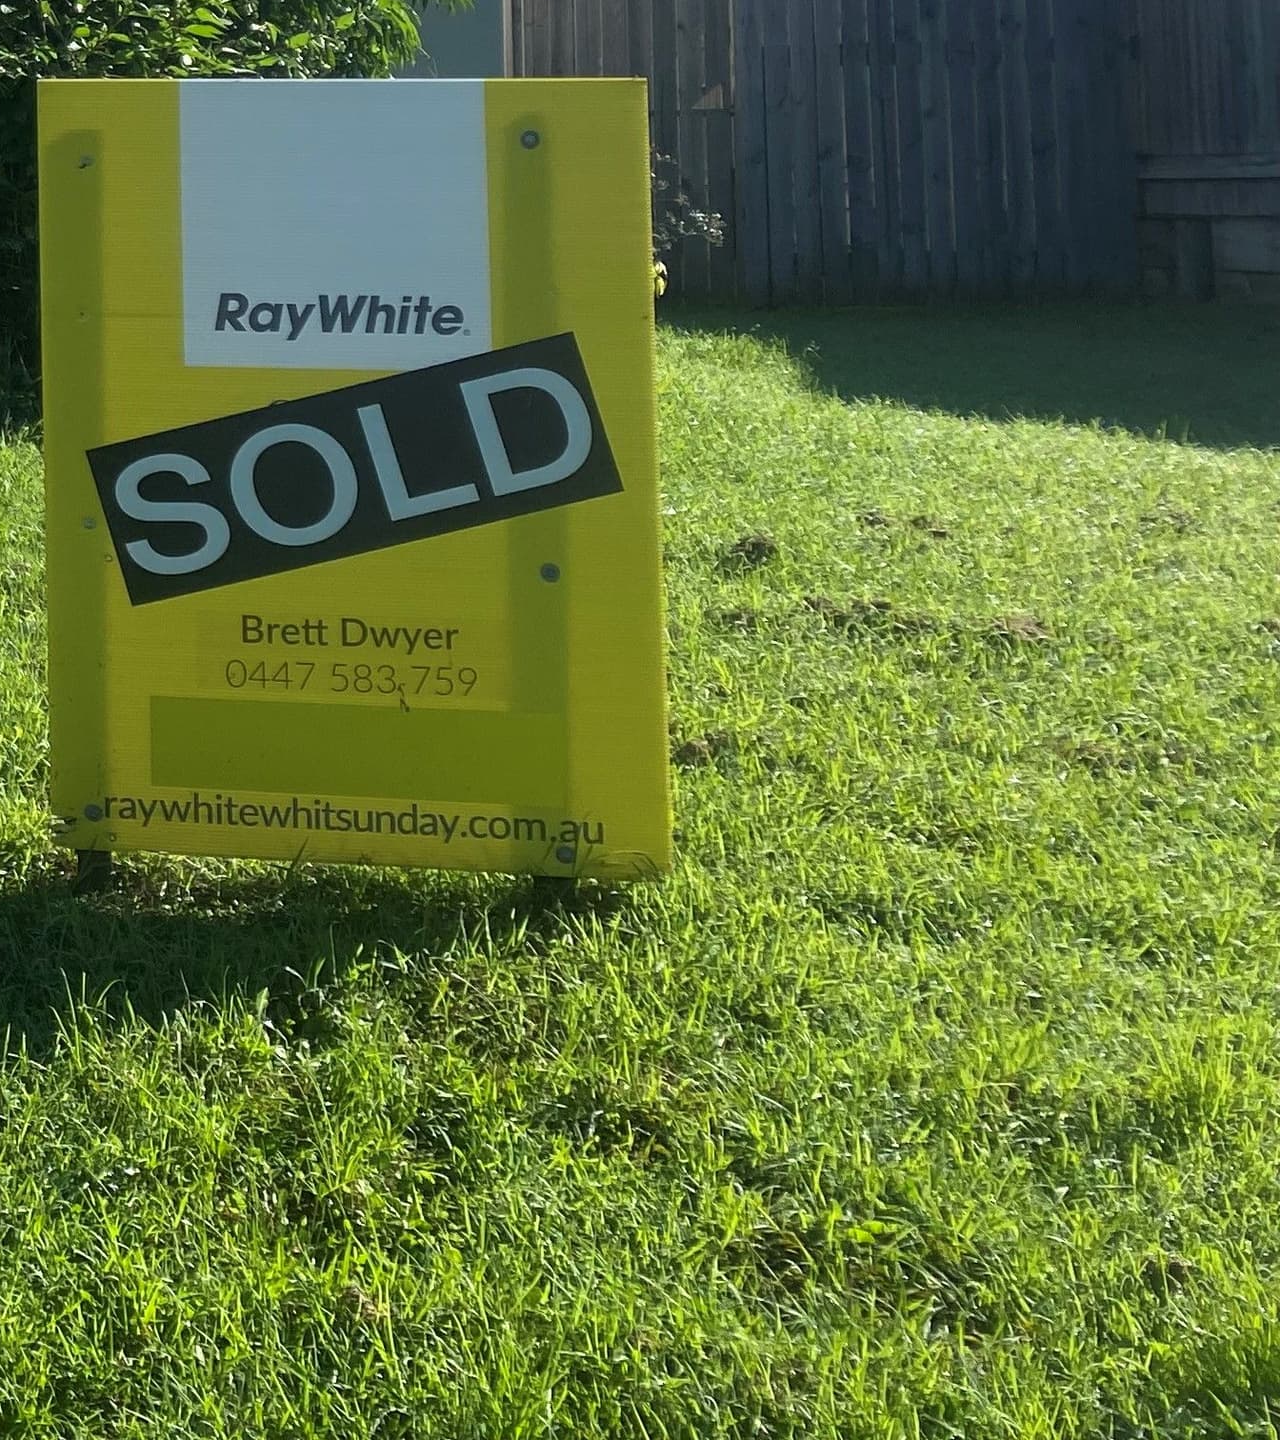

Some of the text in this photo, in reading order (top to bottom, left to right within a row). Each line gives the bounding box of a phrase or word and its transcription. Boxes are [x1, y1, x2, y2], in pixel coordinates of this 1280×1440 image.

[113, 367, 593, 575] SOLD
[241, 614, 459, 655] Brett Dwyer
[225, 659, 478, 697] 0447 583 759
[103, 791, 605, 846] raywhitewhitsunday.com.au
